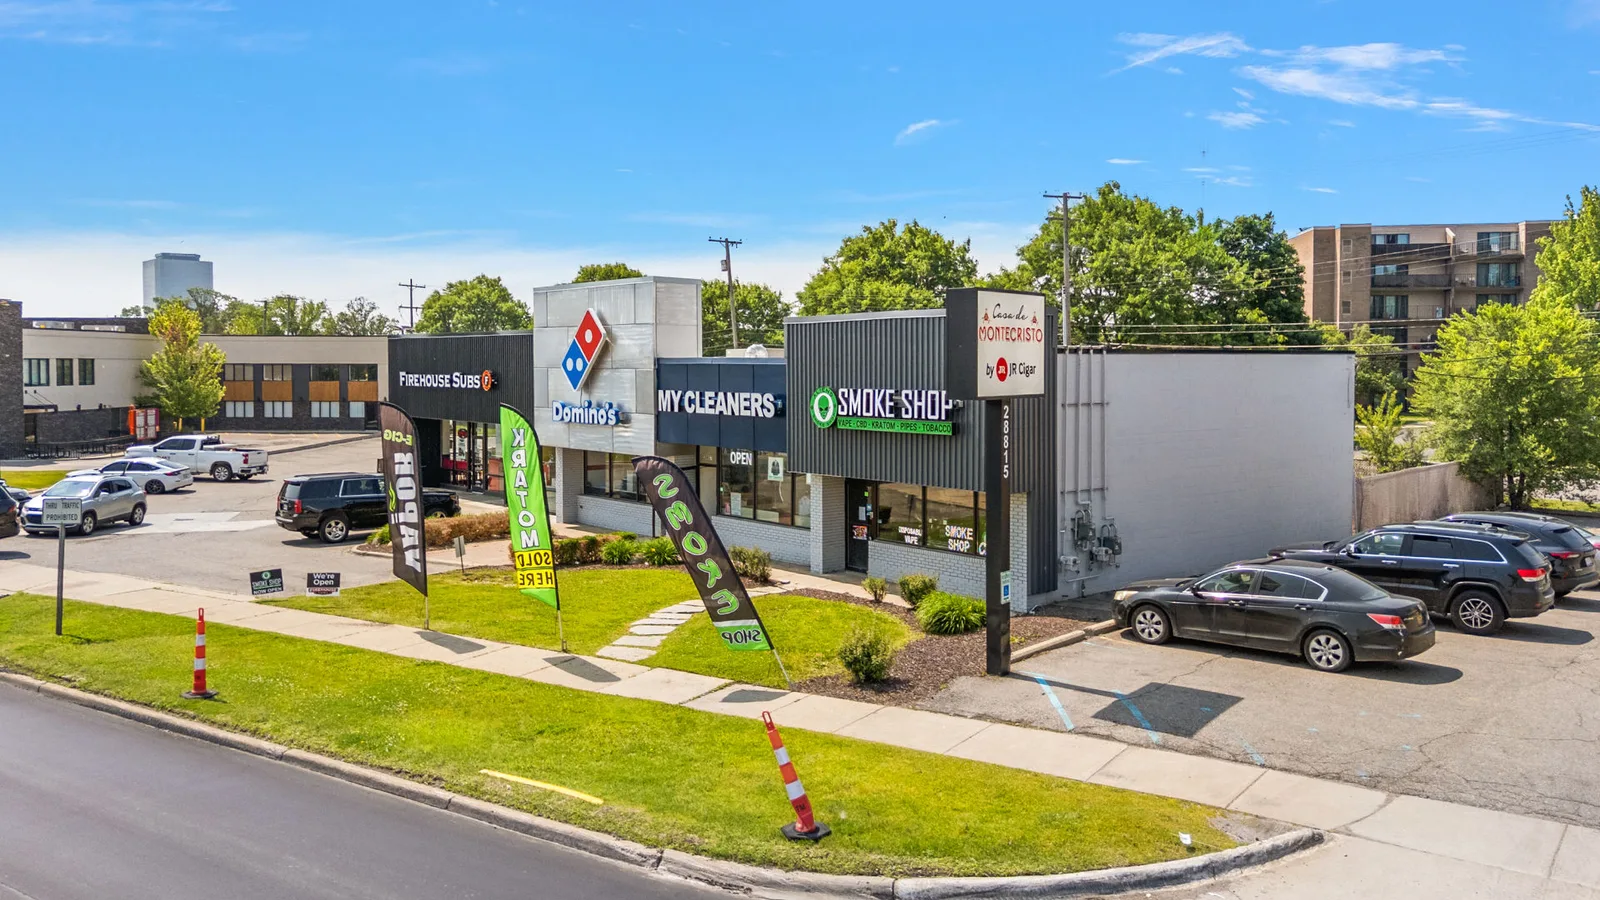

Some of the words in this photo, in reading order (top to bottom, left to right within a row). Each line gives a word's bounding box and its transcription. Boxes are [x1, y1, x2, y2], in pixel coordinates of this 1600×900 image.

[992, 303, 1015, 319] Casa
[1015, 305, 1028, 320] de
[978, 325, 1043, 343] MONTECRISTO
[986, 363, 994, 378] by
[1009, 362, 1017, 376] JR
[1018, 362, 1036, 377] Cigar
[399, 371, 450, 387] FIREHOUSE
[452, 372, 480, 388] SUBS
[658, 389, 682, 412] MY
[684, 391, 775, 418] CLEANERS
[838, 388, 895, 417] SMOKE
[552, 400, 617, 426] Domino's
[838, 419, 852, 428] VAPE
[856, 420, 867, 428] CBD
[872, 422, 895, 430] KRATOM
[901, 423, 917, 431] PIPES
[922, 424, 951, 433] TOBACCO
[730, 451, 752, 465] OPEN
[46, 513, 78, 521] PROHIBITED
[904, 535, 918, 545] VAPE
[945, 524, 973, 540] SMOKE
[948, 538, 970, 552] SHOP
